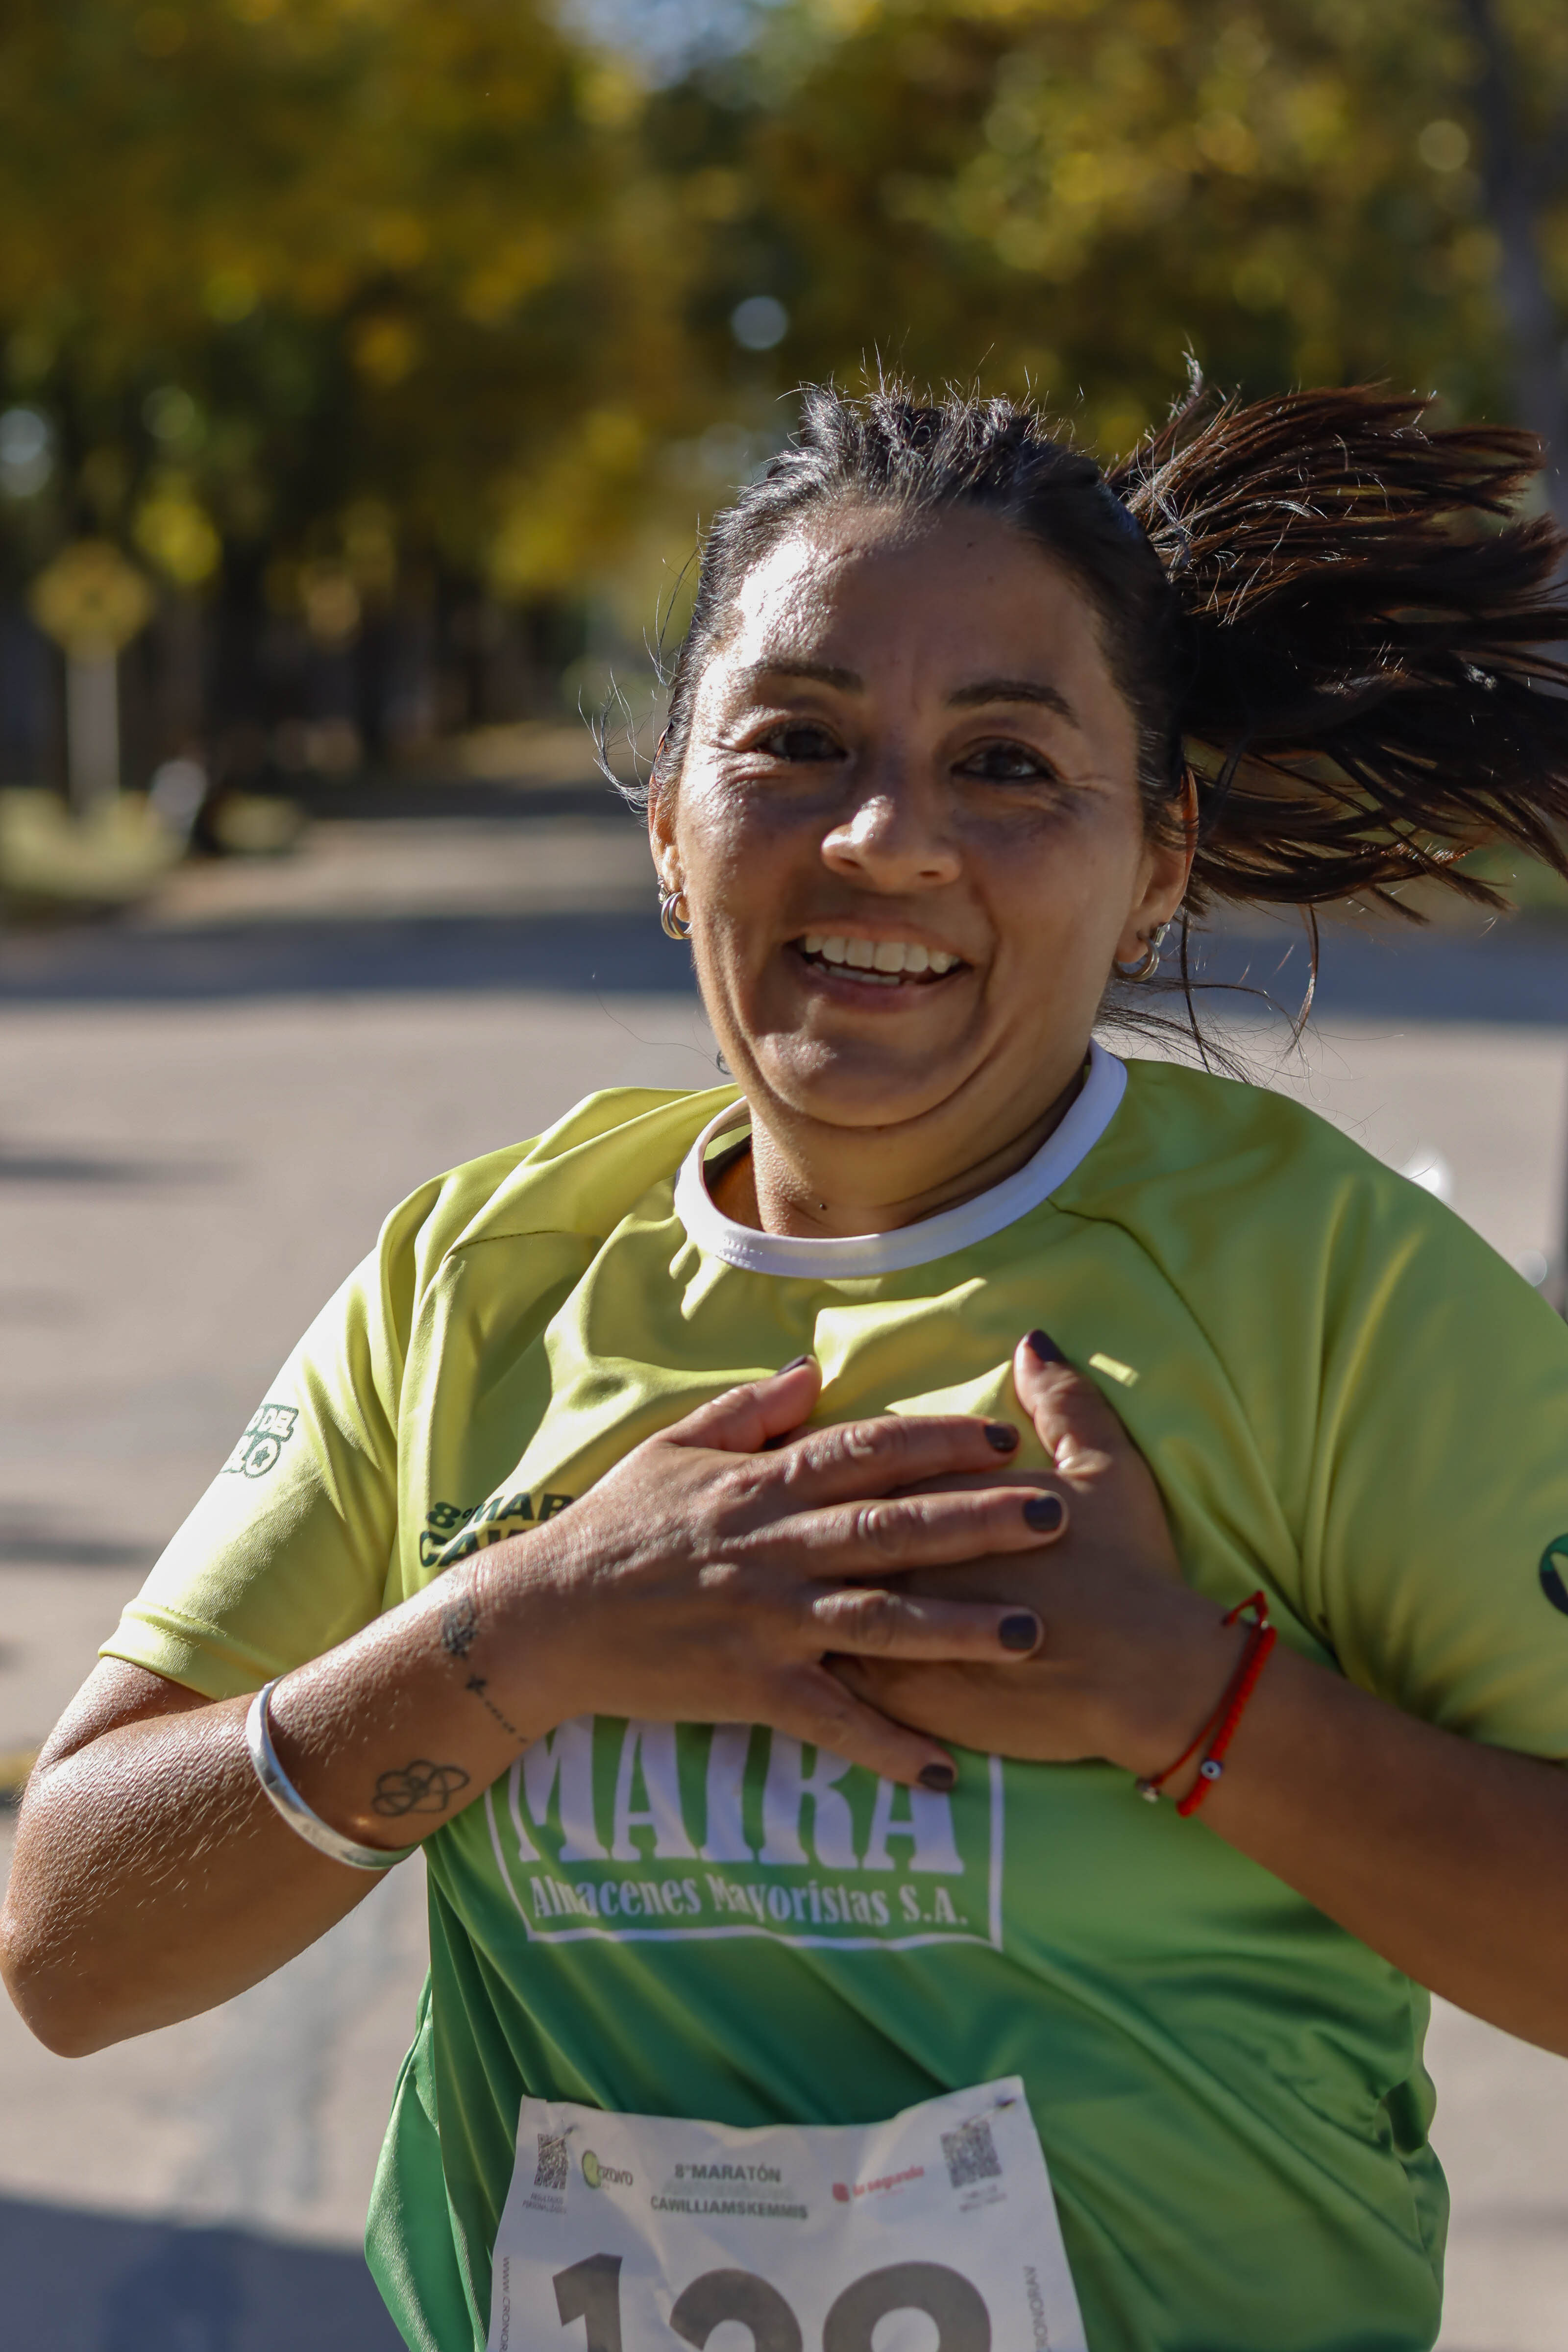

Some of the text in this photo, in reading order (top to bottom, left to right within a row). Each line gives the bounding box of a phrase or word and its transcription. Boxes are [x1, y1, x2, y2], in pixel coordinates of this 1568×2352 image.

[530, 1873, 968, 1926] Almacenes Mayoristas S.A.
